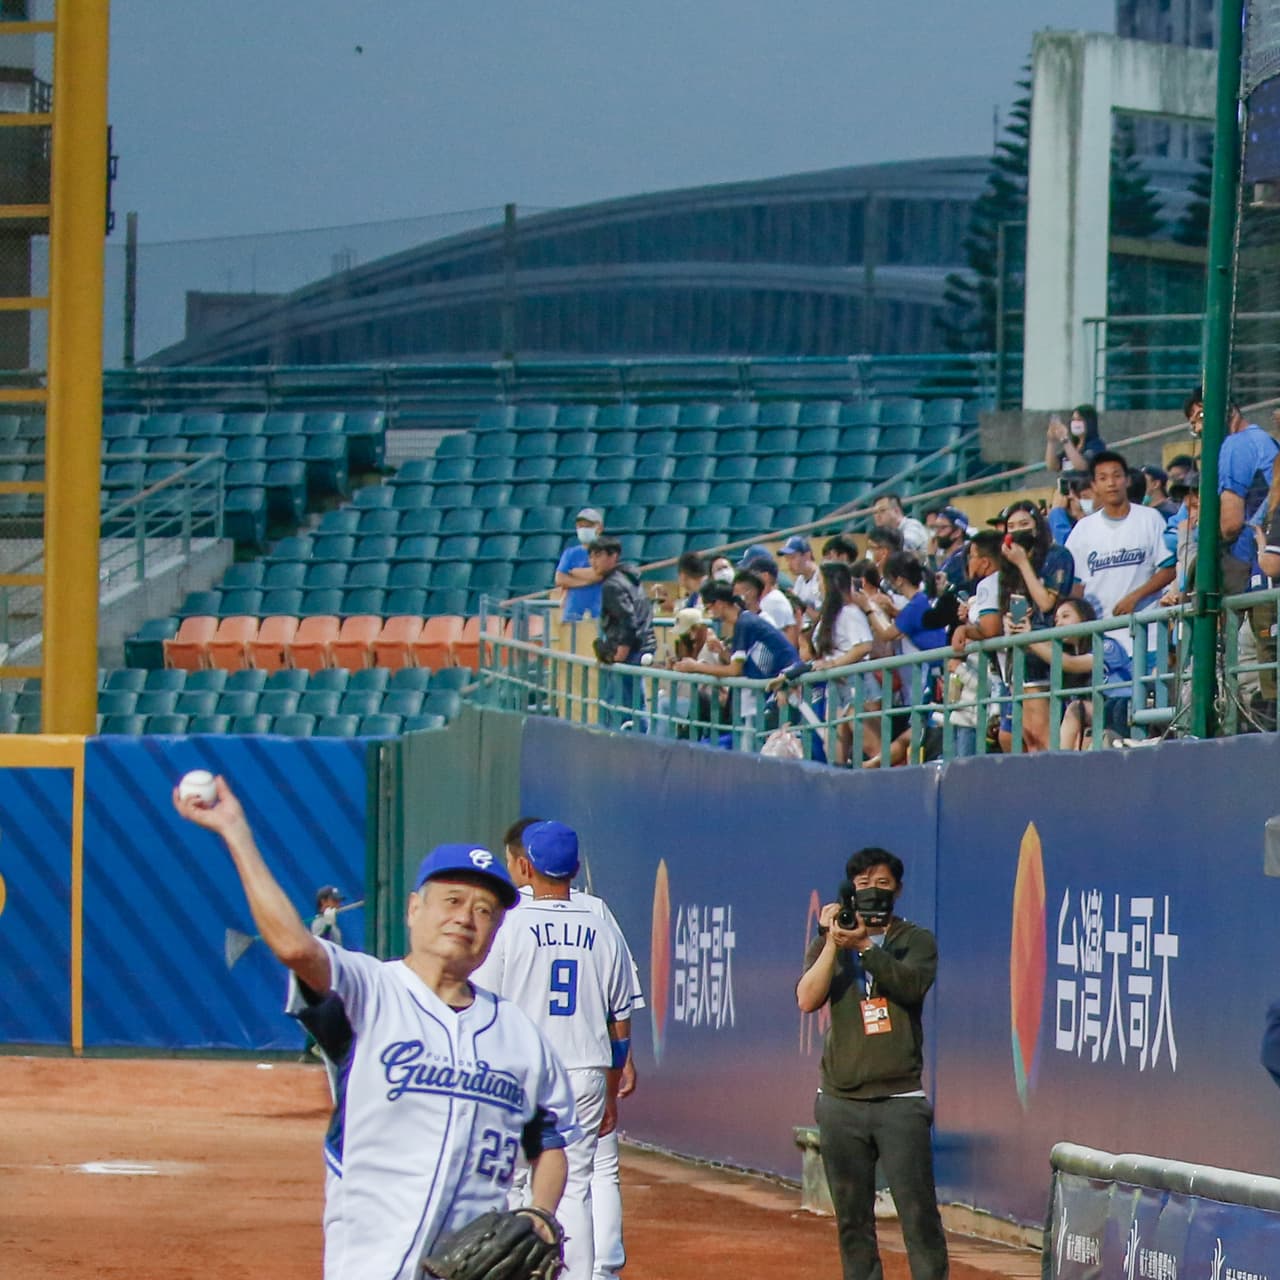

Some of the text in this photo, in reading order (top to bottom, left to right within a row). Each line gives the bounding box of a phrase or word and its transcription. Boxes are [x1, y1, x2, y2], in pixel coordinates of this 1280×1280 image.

[529, 922, 597, 951] Y.C.LIN
[674, 904, 736, 1031] 台灣大哥大
[549, 959, 578, 1016] 9
[1055, 887, 1179, 1073] 台灣大哥大
[380, 1040, 526, 1114] Guardians
[475, 1128, 518, 1184] 23
